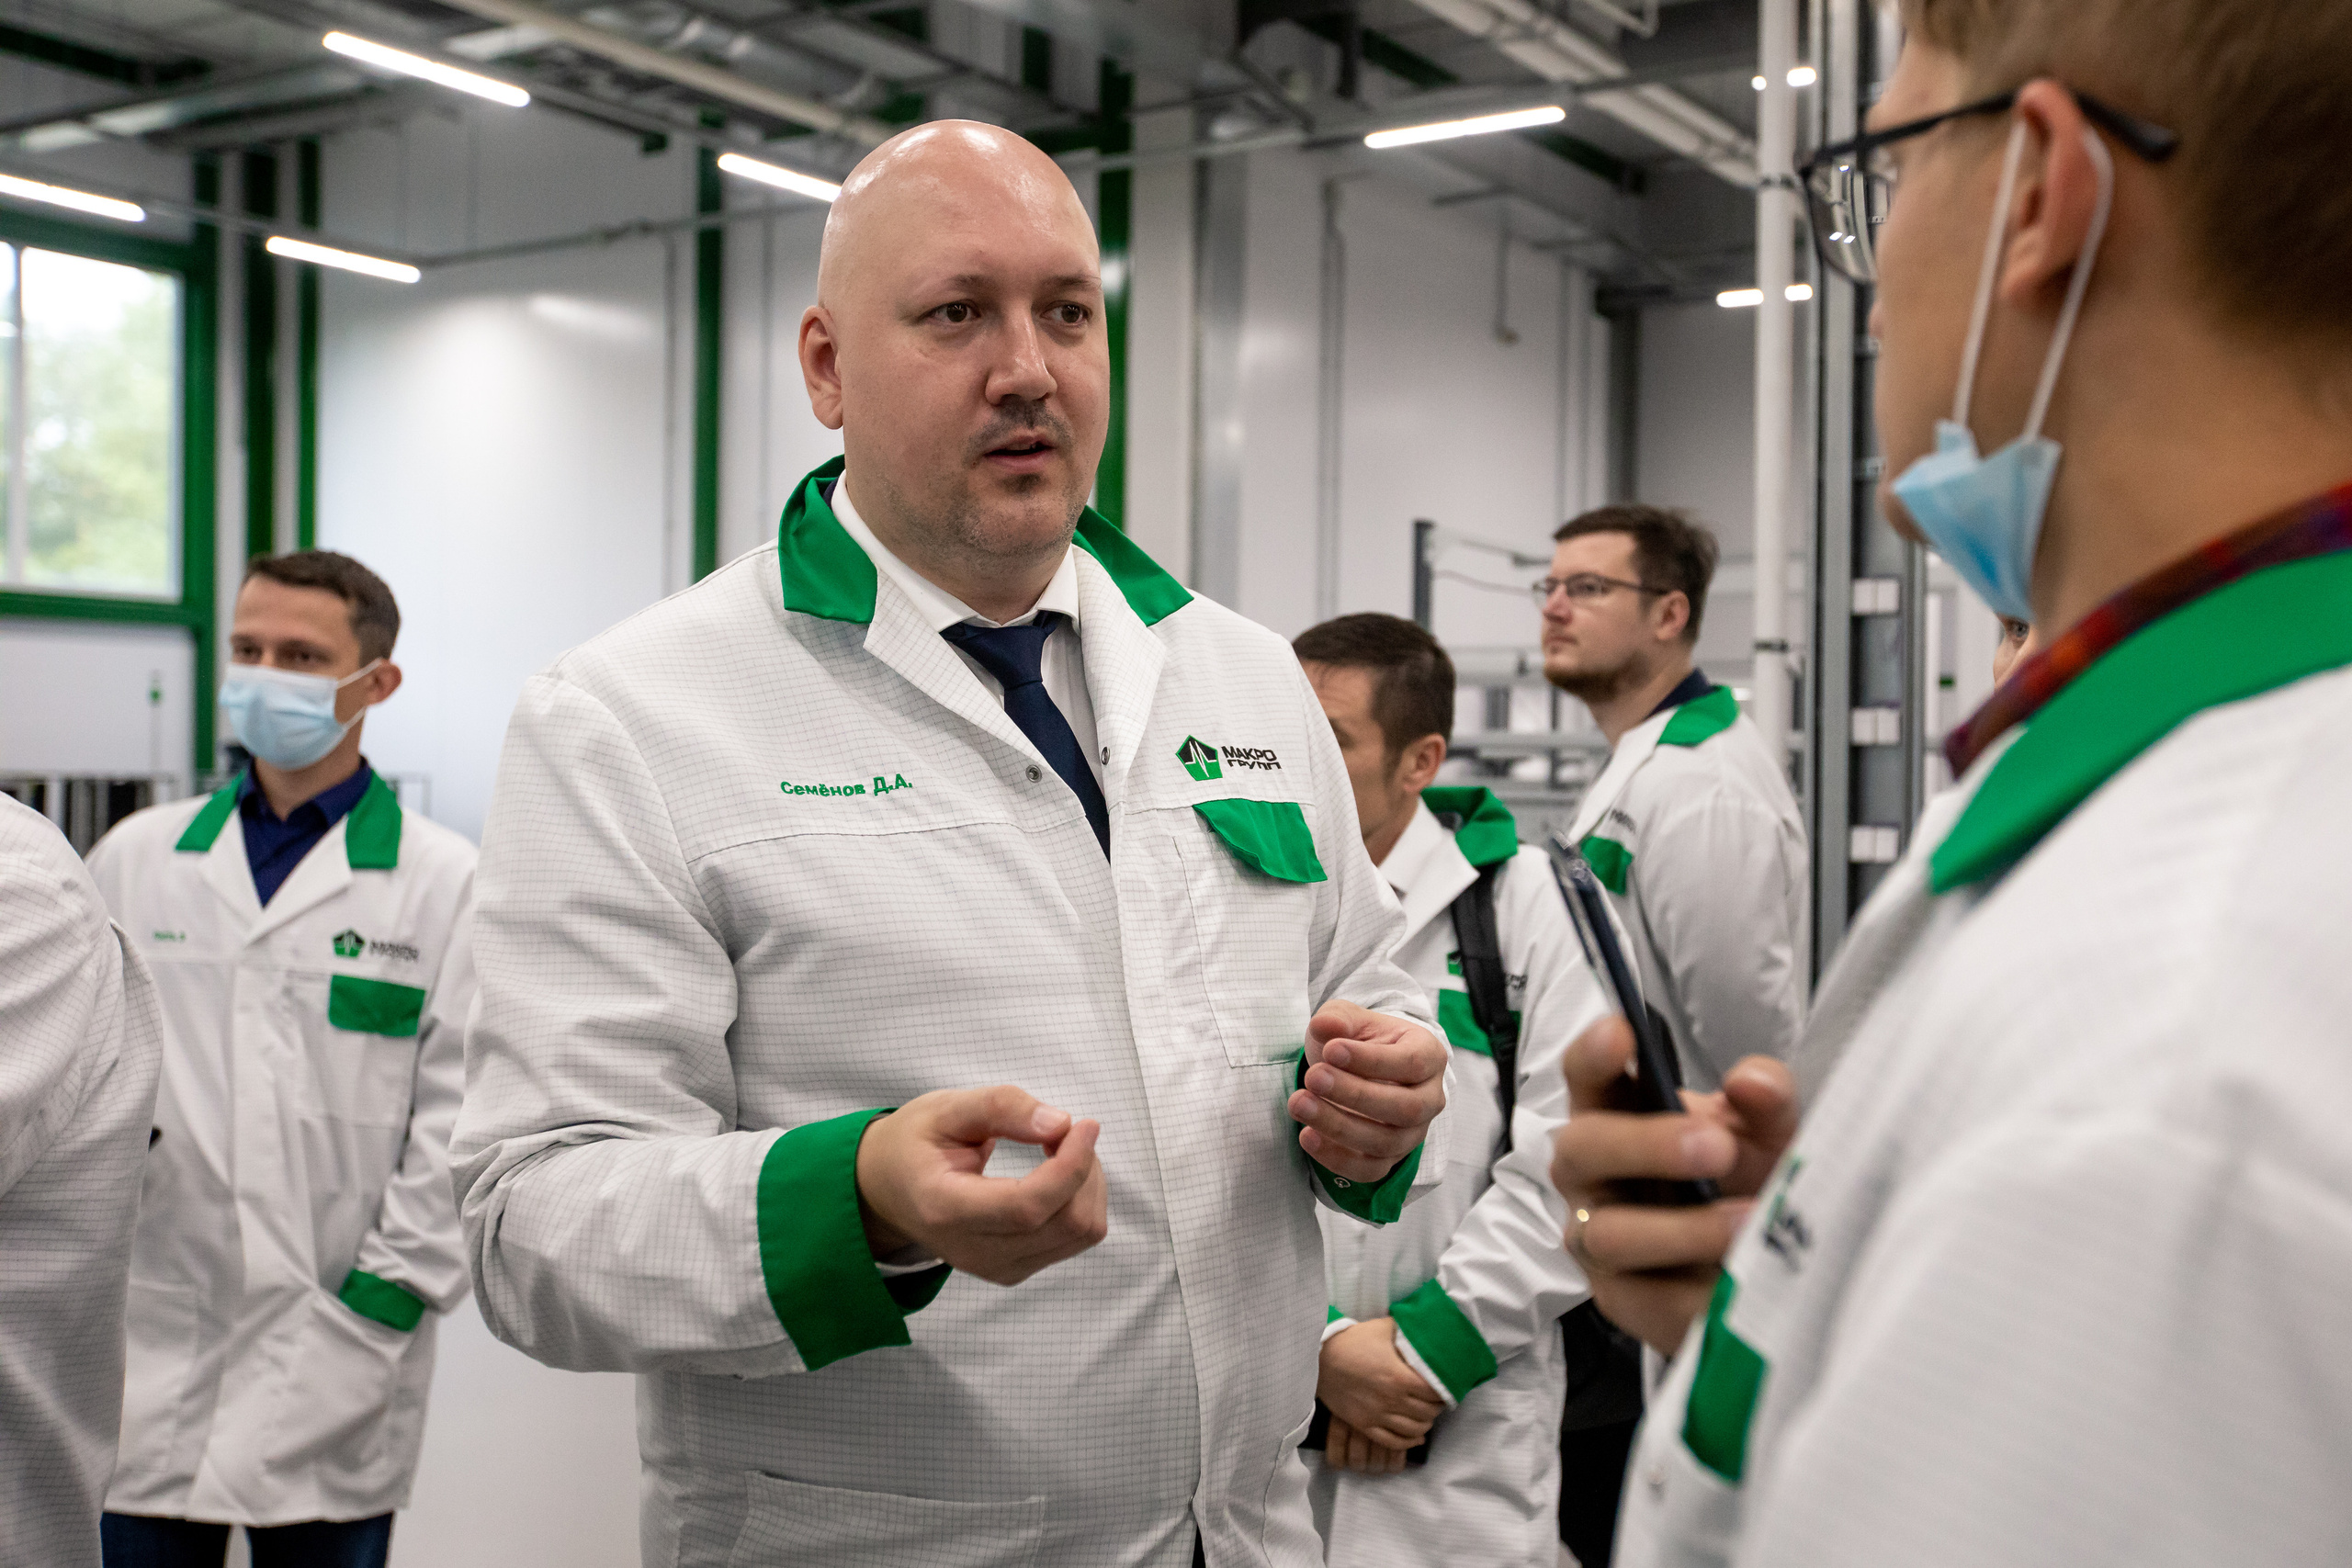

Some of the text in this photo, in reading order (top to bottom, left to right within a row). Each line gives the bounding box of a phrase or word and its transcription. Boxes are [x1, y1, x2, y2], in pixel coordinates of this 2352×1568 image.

[1221, 746, 1277, 761] МАКРО
[780, 773, 912, 797] Семёнов Д.А.
